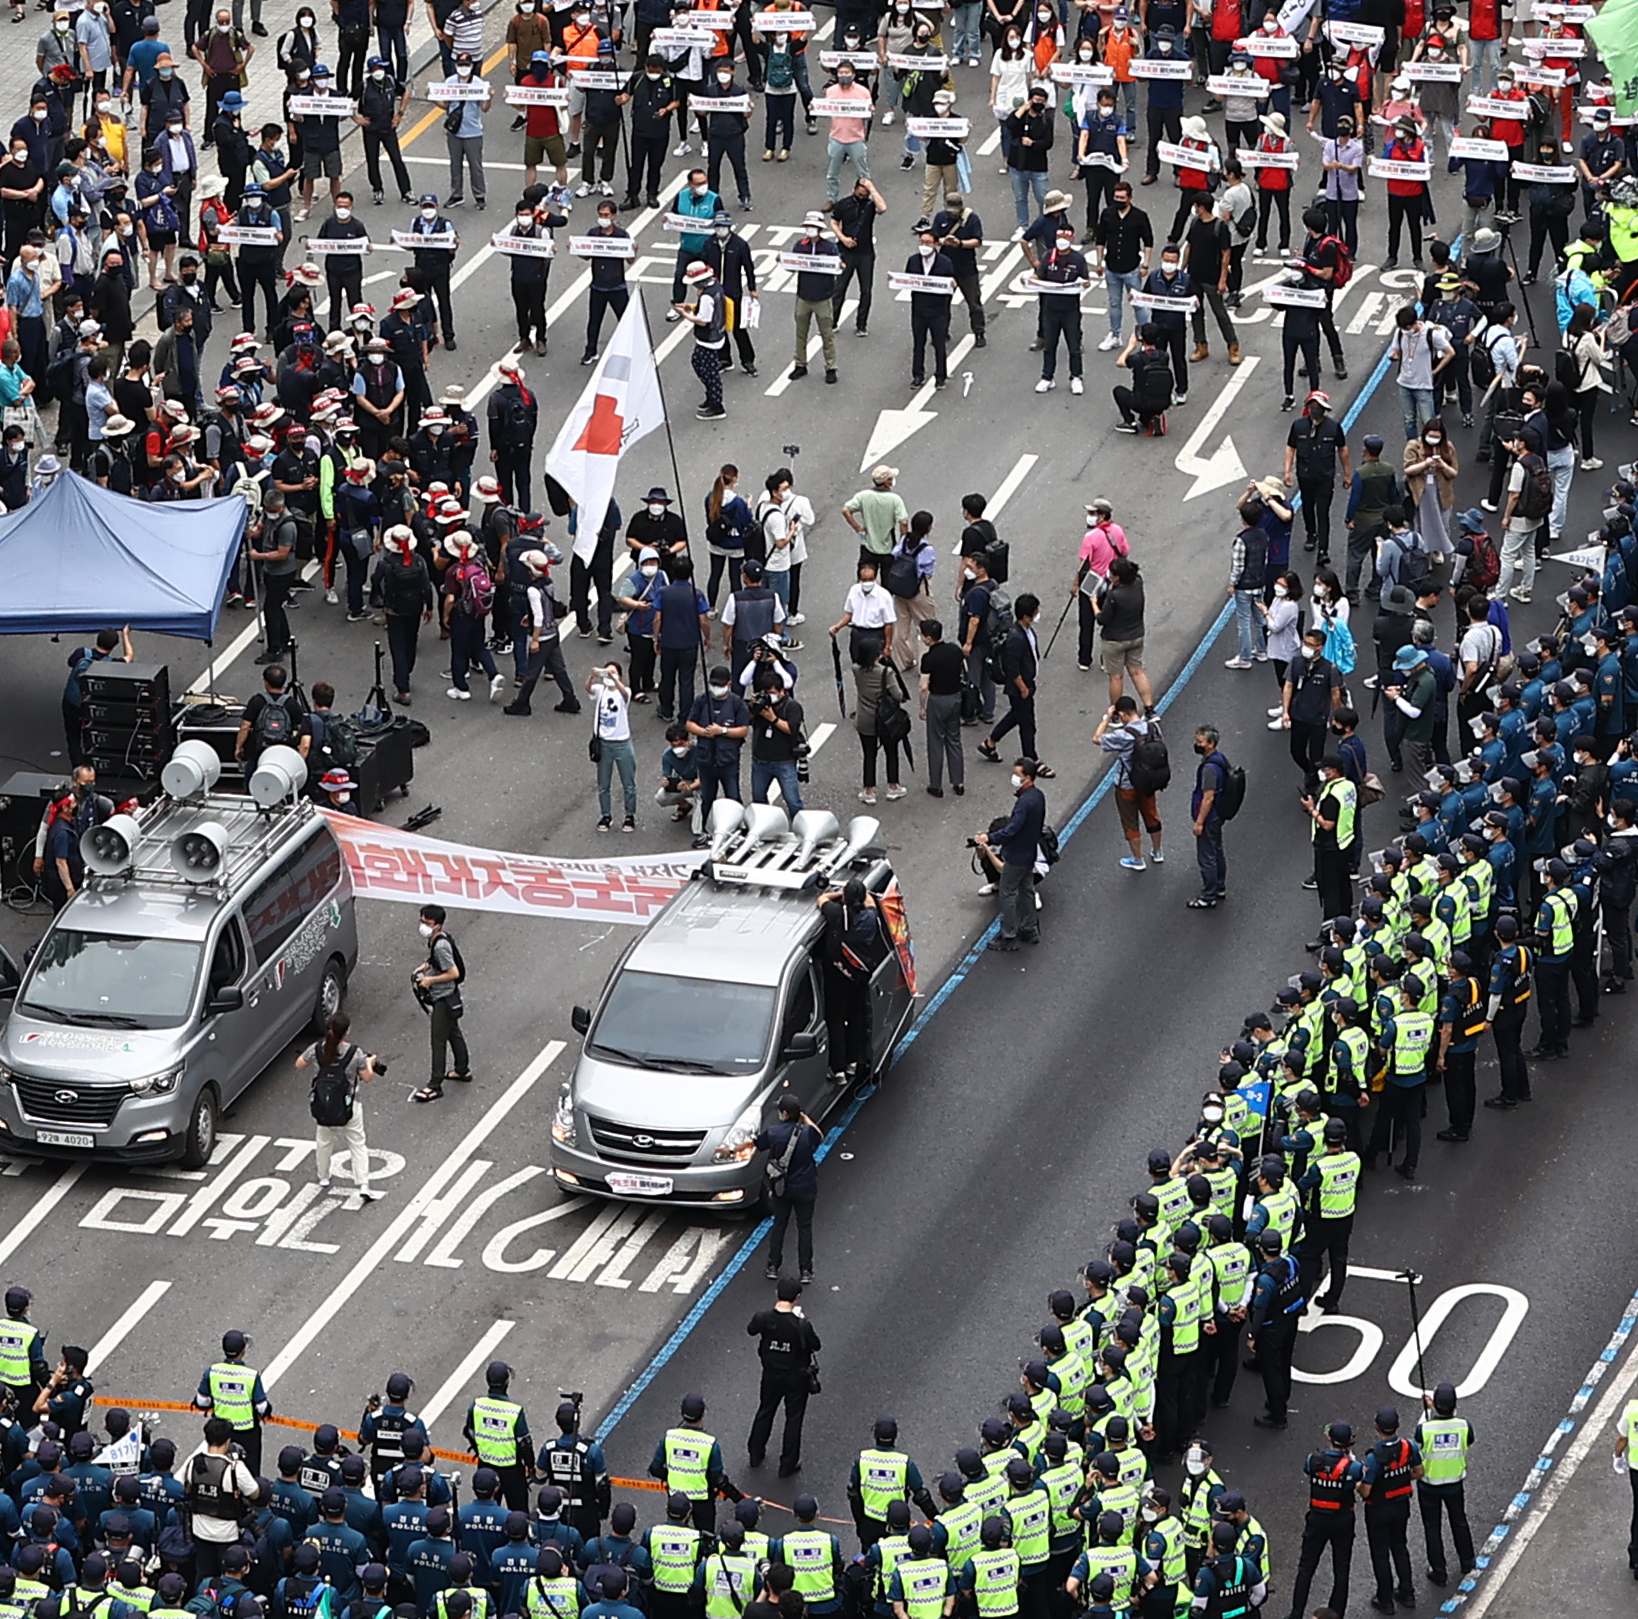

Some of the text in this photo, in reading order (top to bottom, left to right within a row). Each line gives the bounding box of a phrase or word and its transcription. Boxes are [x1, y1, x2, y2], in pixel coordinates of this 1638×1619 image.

[64, 1135, 88, 1146] 4020
[1289, 1264, 1530, 1400] 50
[1313, 1476, 1342, 1488] POLICE
[1220, 1585, 1245, 1596] POLICE
